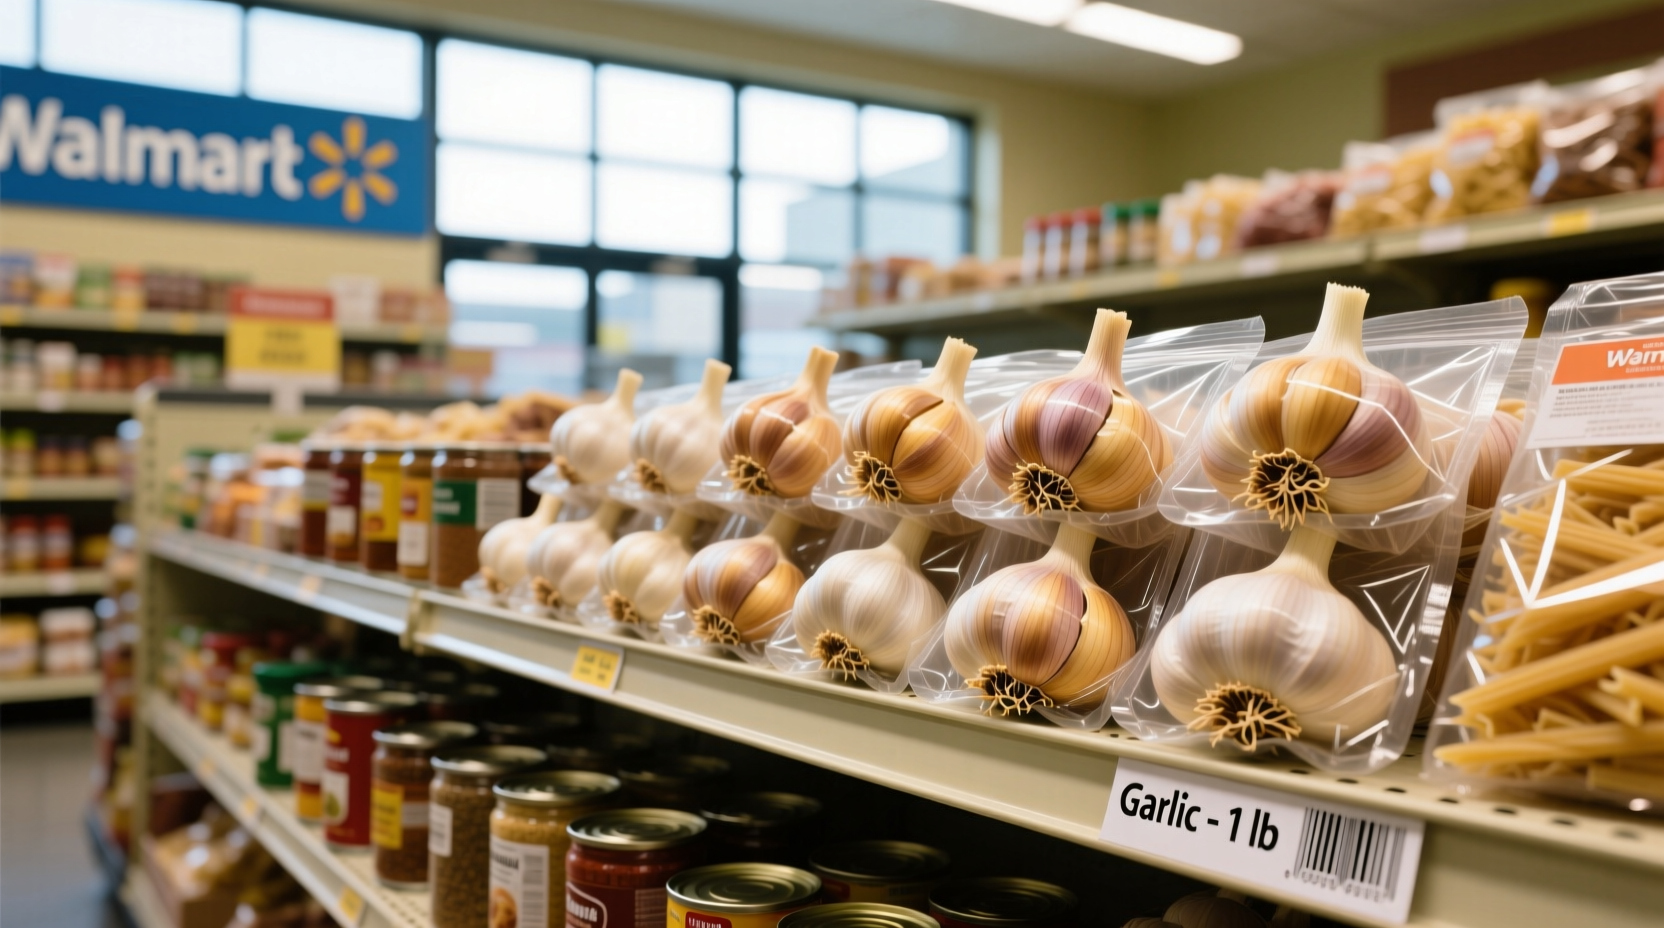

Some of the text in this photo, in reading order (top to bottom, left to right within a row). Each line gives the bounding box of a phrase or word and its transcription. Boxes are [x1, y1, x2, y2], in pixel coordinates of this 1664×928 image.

[0, 94, 304, 201] Walmart
[1120, 782, 1279, 851] Garlic - 1 lb
